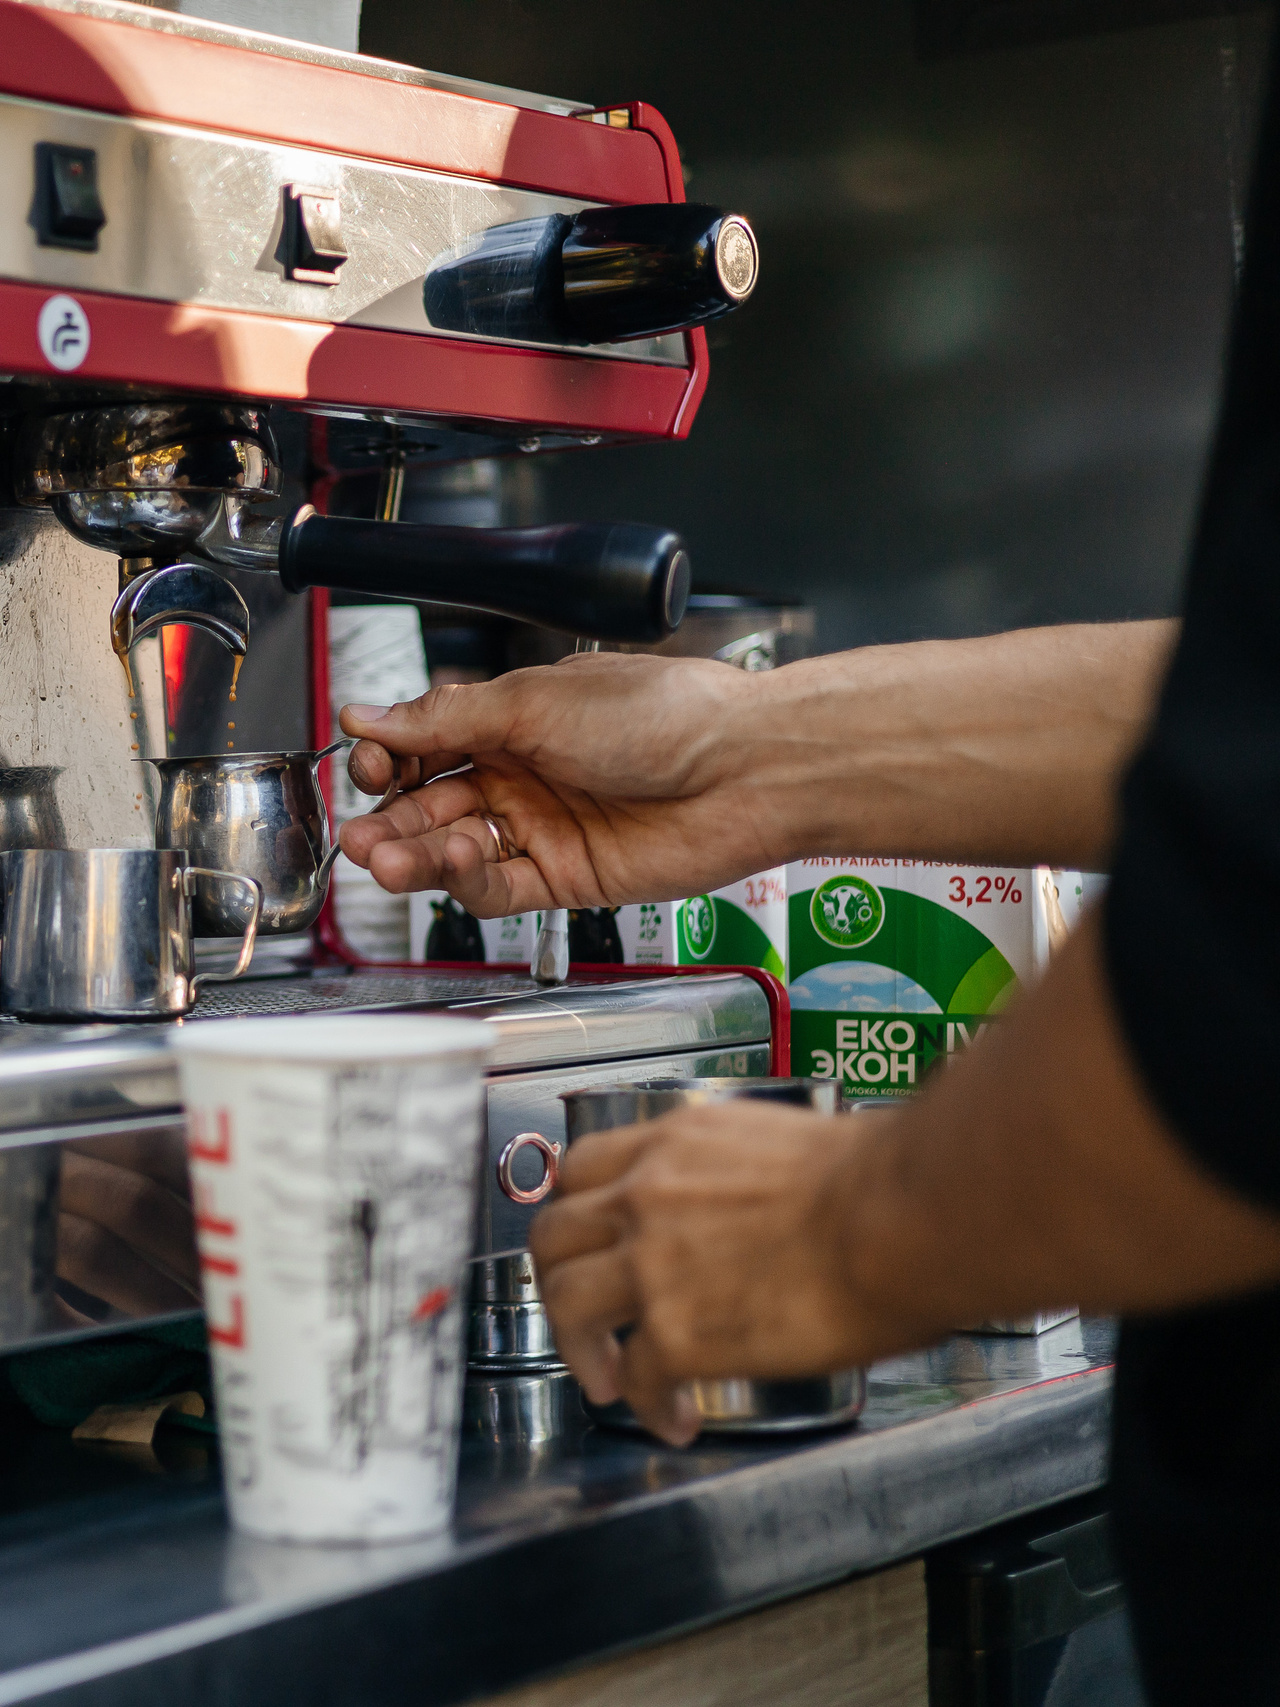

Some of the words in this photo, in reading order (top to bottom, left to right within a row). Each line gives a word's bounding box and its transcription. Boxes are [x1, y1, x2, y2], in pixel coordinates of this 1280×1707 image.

[948, 876, 1022, 908] 3,2%
[835, 1019, 990, 1052] EKONIV
[845, 1086, 880, 1096] ОЛОКО,
